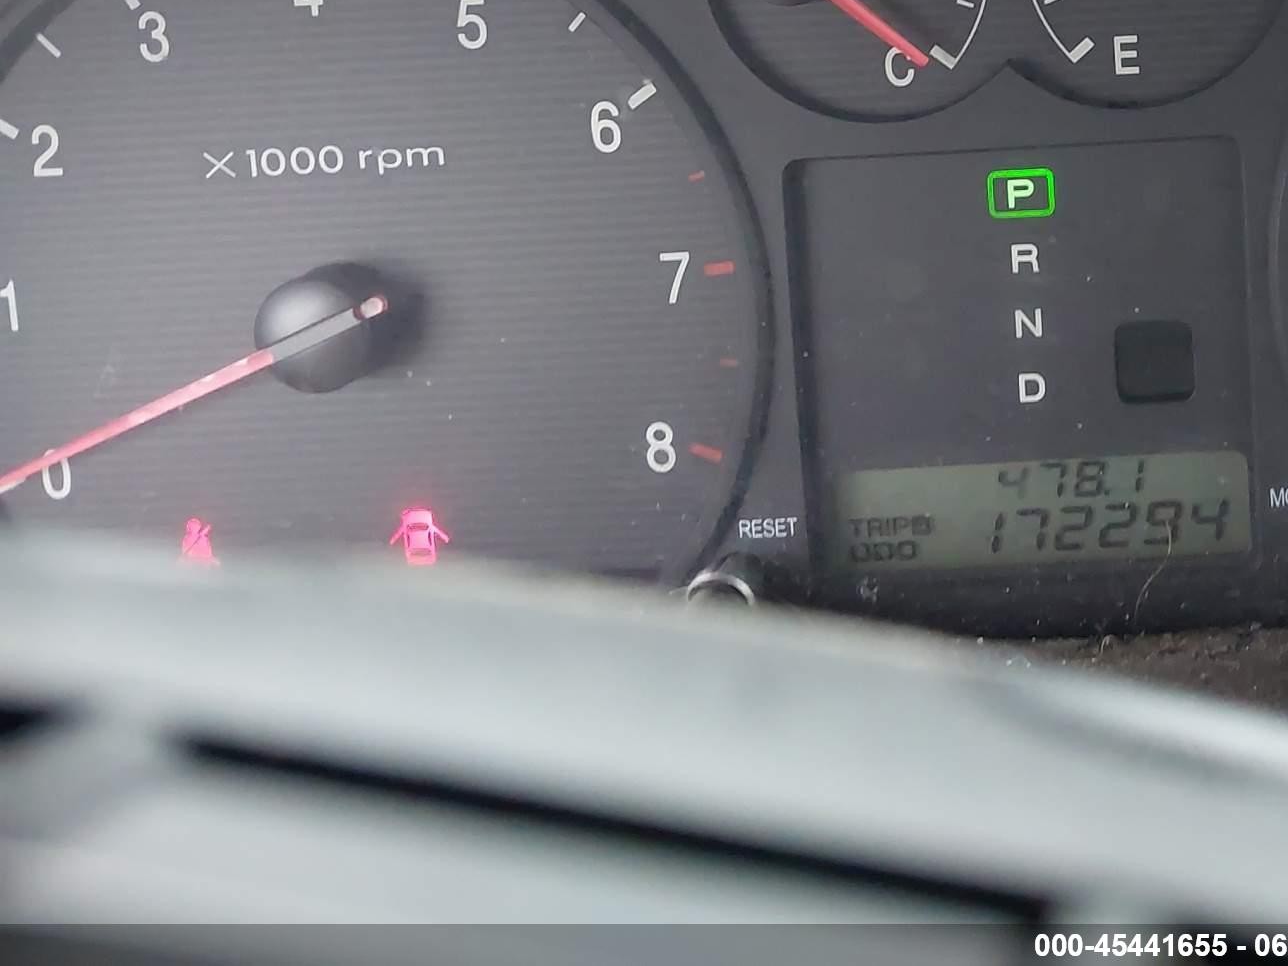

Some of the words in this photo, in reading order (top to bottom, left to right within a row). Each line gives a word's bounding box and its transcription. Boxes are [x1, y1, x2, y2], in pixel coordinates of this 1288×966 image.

[138, 11, 171, 62] 3
[1113, 34, 1141, 76] E
[884, 46, 915, 87] C
[590, 101, 622, 153] 6
[30, 124, 64, 178] 2
[358, 141, 446, 175] rpm
[1006, 178, 1035, 209] P
[659, 250, 691, 305] 7
[1010, 243, 1040, 275] R
[0, 277, 20, 333] 1
[1014, 308, 1044, 339] N
[1018, 373, 1047, 404] D
[645, 420, 678, 474] 8
[39, 448, 73, 499] 0
[997, 458, 1146, 498] 478.1
[738, 515, 798, 540] RESET
[991, 498, 1231, 555] 172294
